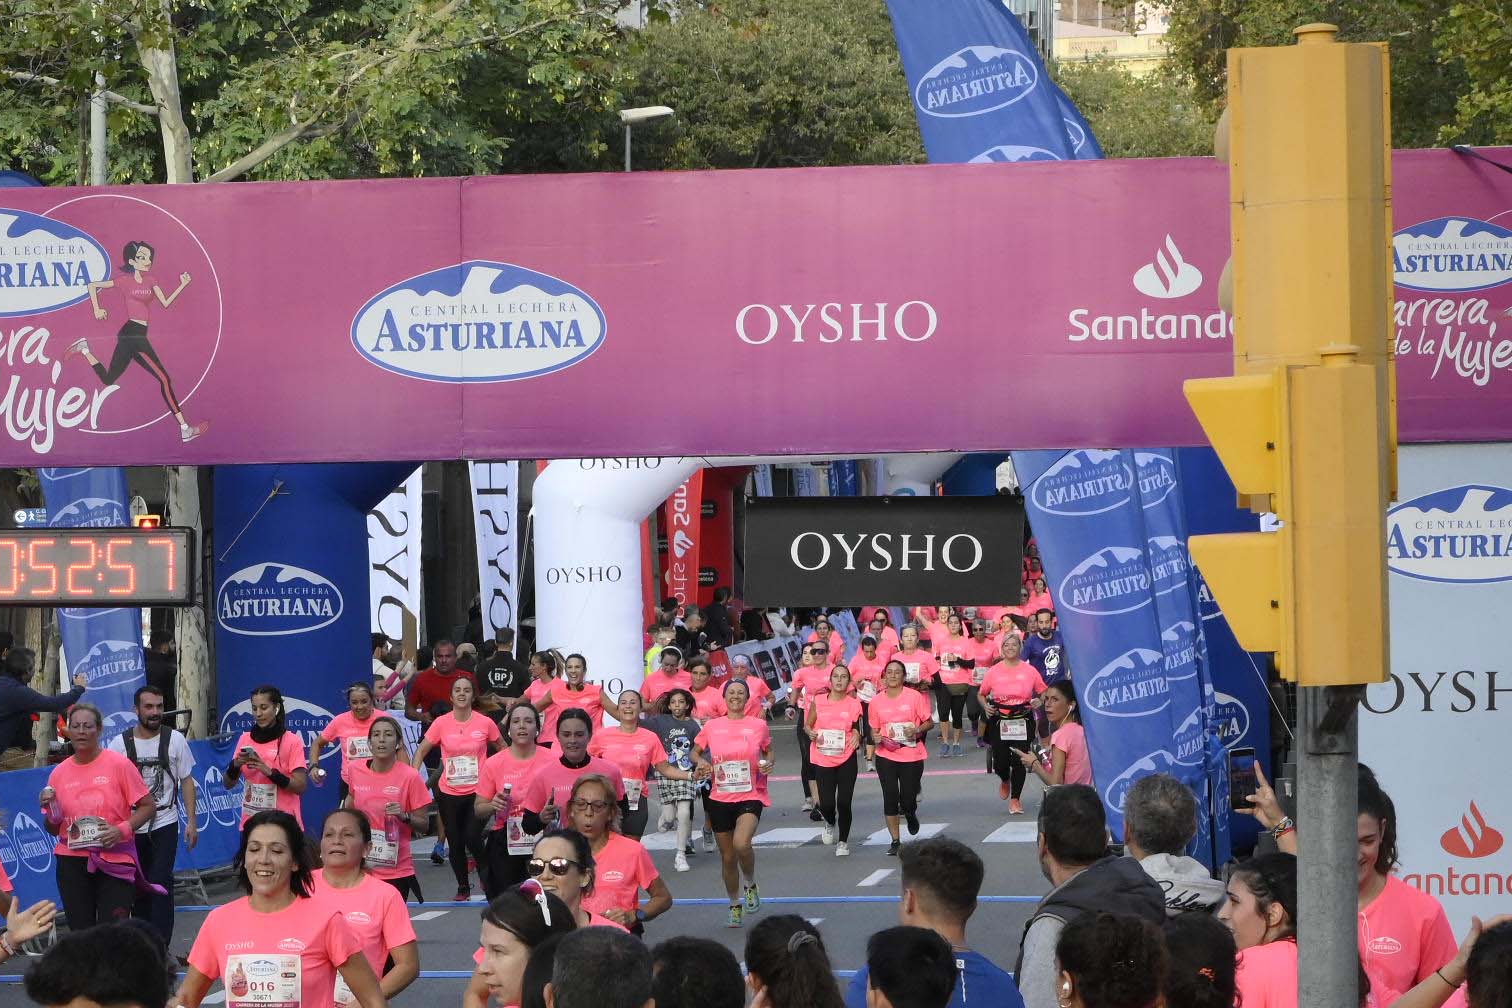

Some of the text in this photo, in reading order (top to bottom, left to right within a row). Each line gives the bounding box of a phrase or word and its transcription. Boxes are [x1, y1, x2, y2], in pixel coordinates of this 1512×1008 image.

[14, 244, 86, 255] LECHERA
[410, 301, 578, 317] CENTRAL LECHERA
[735, 301, 938, 344] OYSHO
[1394, 297, 1489, 327] arrera
[371, 308, 586, 352] ASTURIANA
[1068, 307, 1234, 341] Santand
[1417, 322, 1512, 386] la Muje
[1416, 520, 1481, 530] CENTRAL
[790, 531, 983, 573] OYSHO
[1387, 523, 1512, 559] ASTURI
[547, 565, 622, 585] OYSHO
[234, 587, 329, 596] CENTRAL LECHERA
[221, 592, 334, 619] ASTURIANA
[494, 673, 506, 681] BP
[250, 982, 275, 991] 016
